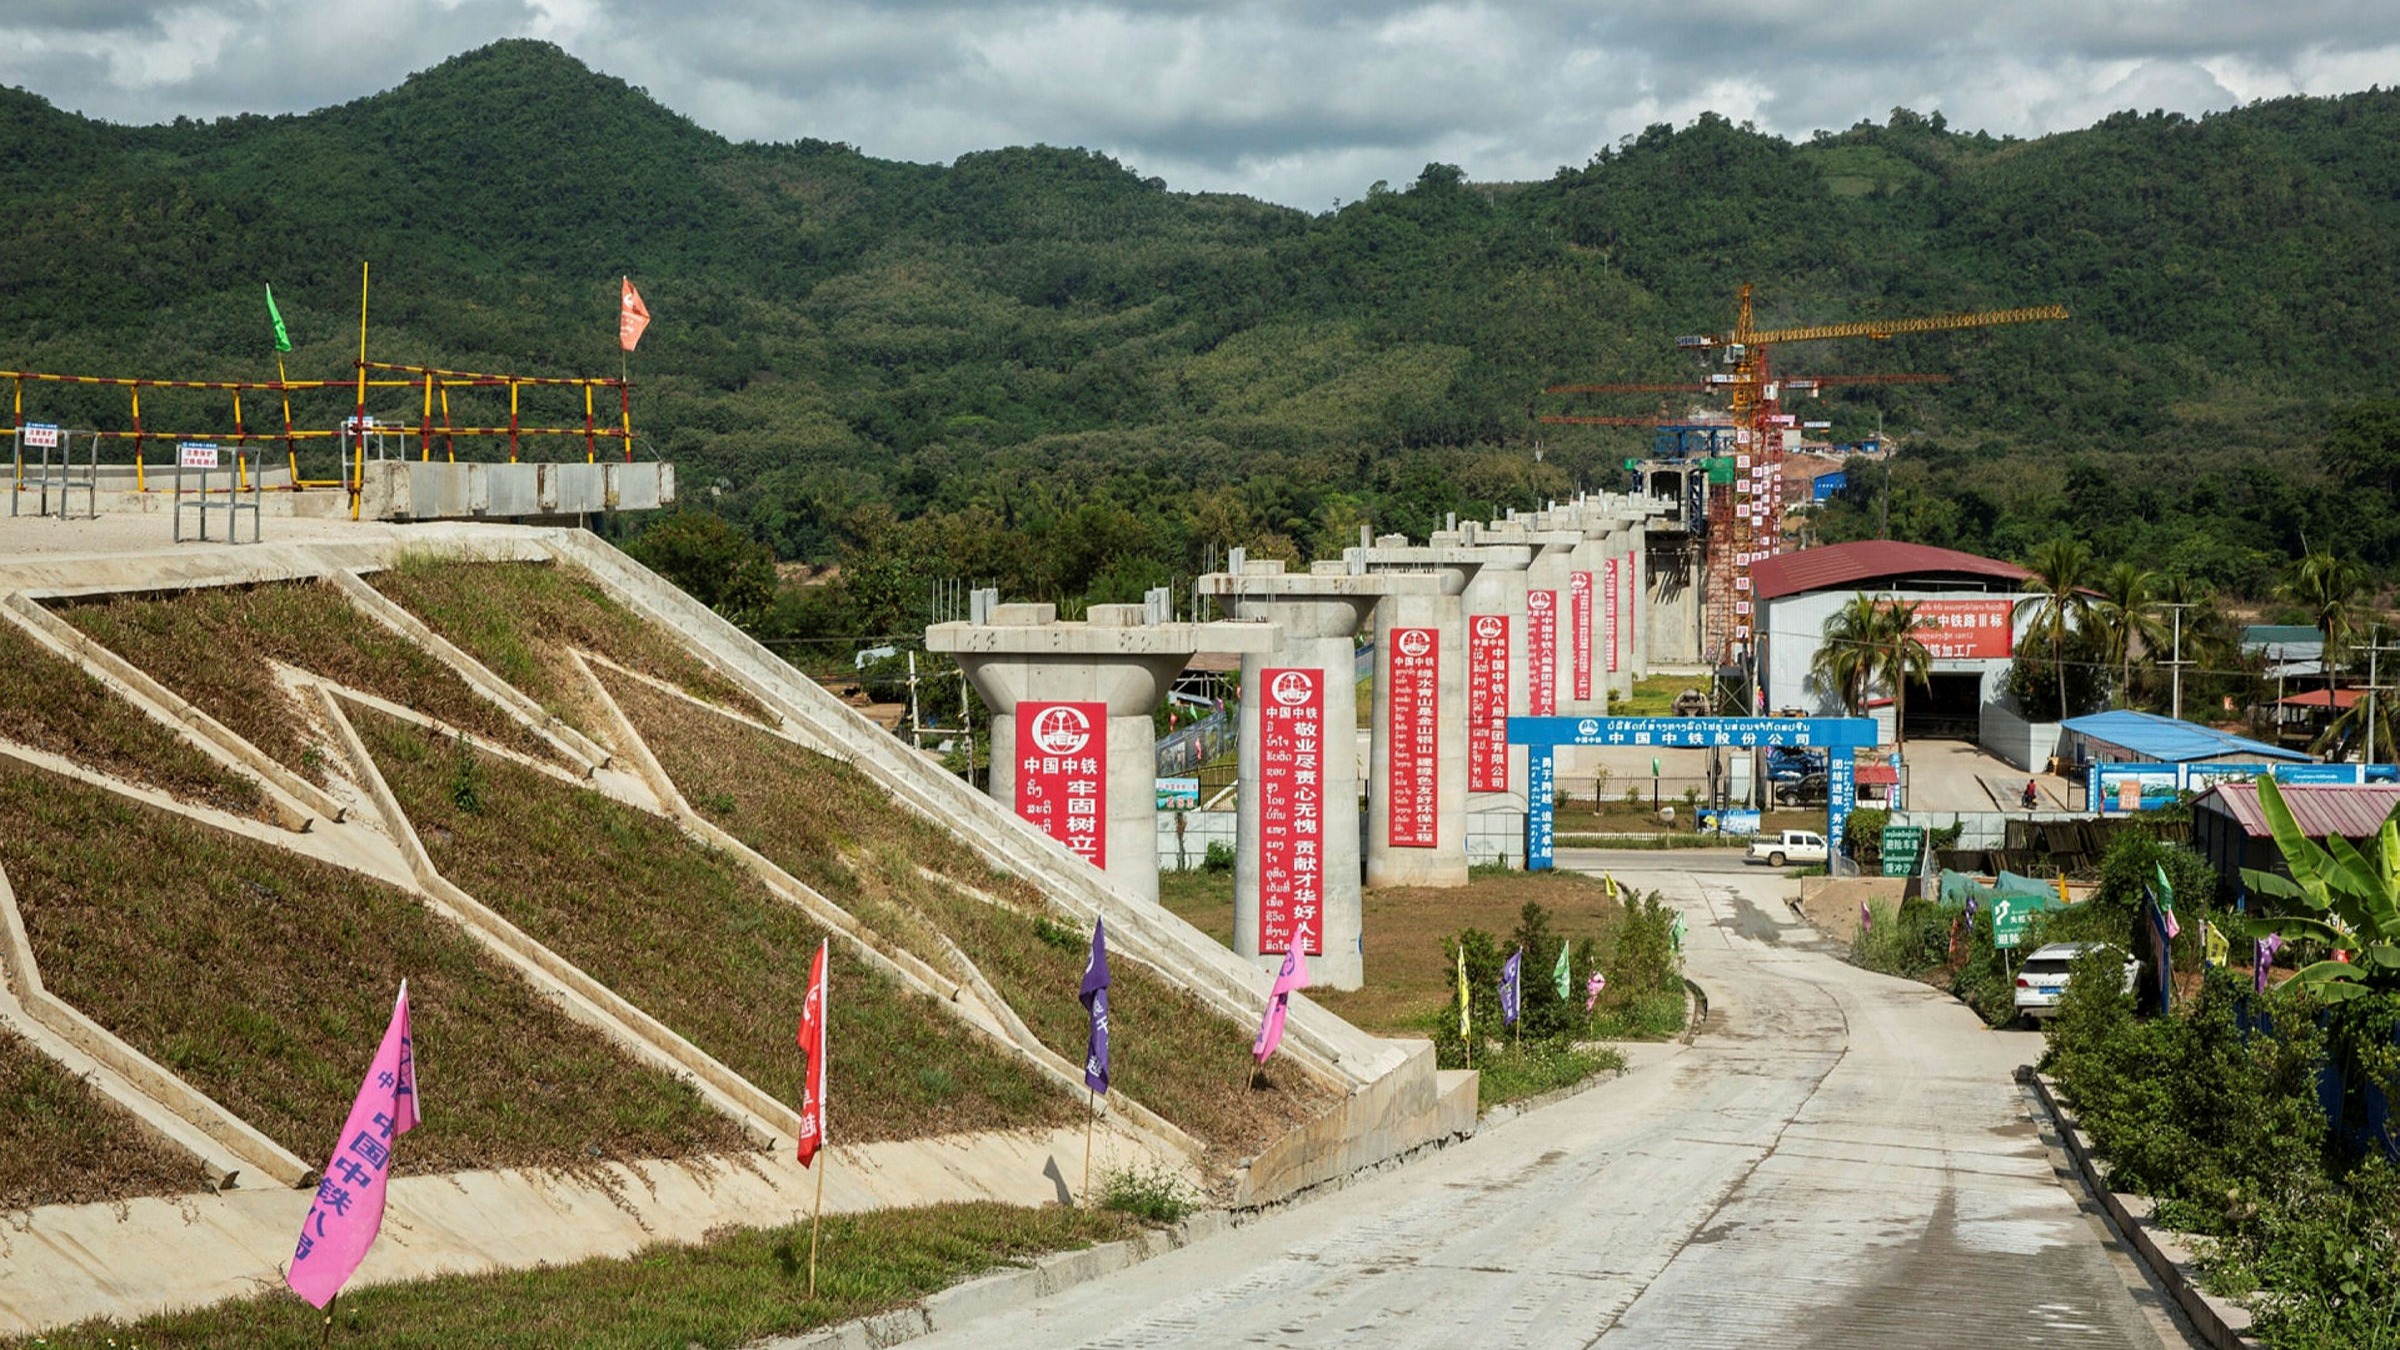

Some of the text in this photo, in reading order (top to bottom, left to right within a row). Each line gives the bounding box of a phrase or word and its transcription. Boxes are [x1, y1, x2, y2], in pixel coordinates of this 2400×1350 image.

[1266, 706, 1318, 719] 中国中铁
[1491, 648, 1505, 788] 中国中铁八局集团有限公司
[1608, 732, 1810, 745] 中国中铁股份公司
[1024, 757, 1098, 775] 中国中铁
[1294, 721, 1317, 834] 敬业尽责心无愧
